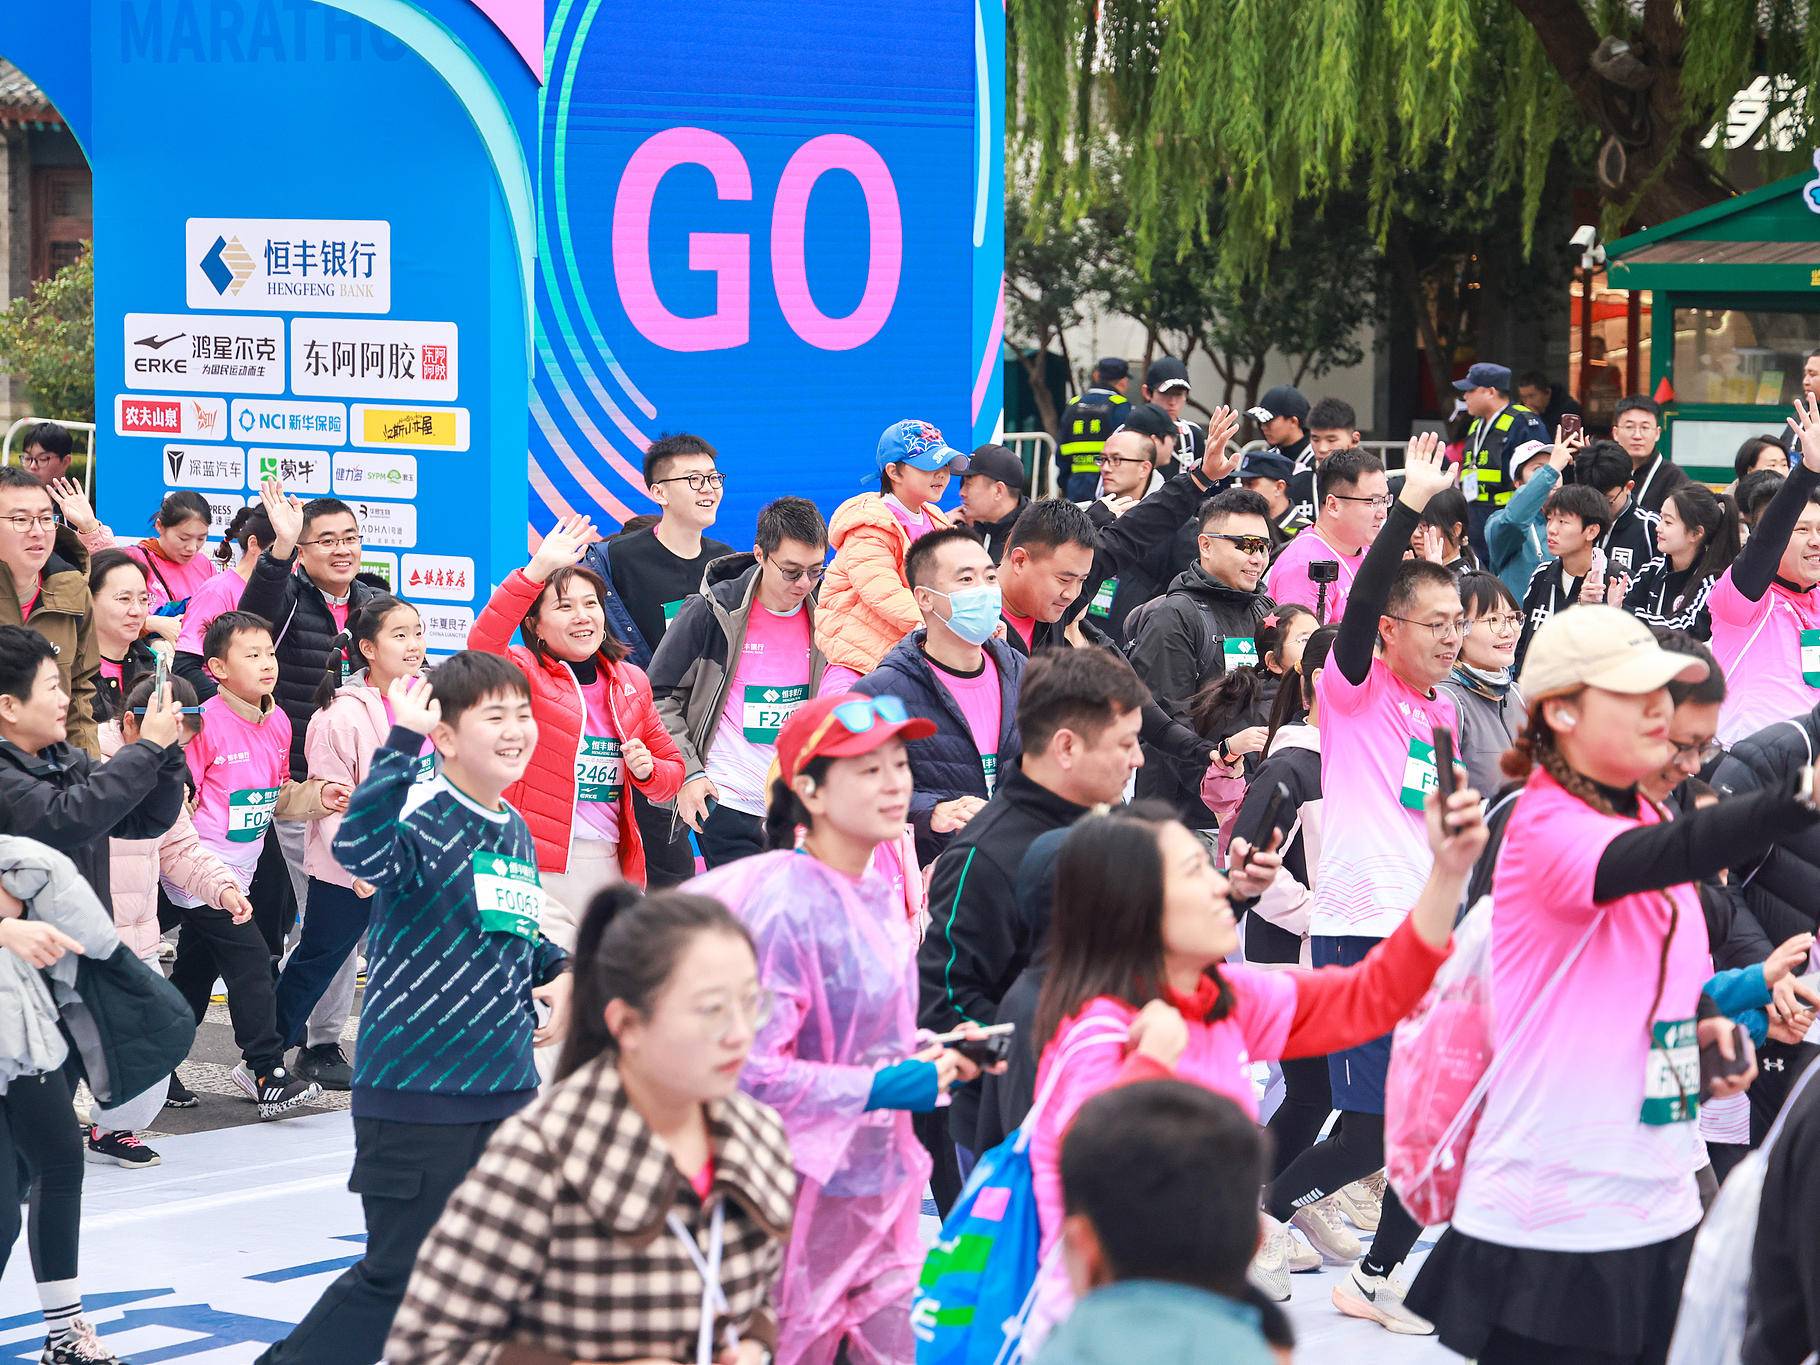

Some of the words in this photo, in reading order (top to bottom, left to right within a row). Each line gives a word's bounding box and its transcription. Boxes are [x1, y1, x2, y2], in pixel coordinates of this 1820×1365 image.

[612, 127, 902, 351] GO
[264, 239, 376, 278] 恒丰银行
[267, 282, 335, 297] HENGFENG
[340, 284, 375, 298] BANK
[192, 335, 275, 360] 鸿星尔克
[134, 358, 187, 373] ERKE
[304, 340, 415, 380] 东阿阿胶
[202, 364, 266, 377] 为国民运动而生
[126, 406, 177, 427] 农夫山泉
[259, 414, 286, 430] NCI
[289, 415, 341, 432] 新华保险
[189, 459, 241, 478] 深蓝汽车
[281, 459, 314, 483] 蒙牛
[336, 466, 363, 481] 健力多
[209, 505, 231, 514] PRESS
[424, 568, 465, 587] 银座家居
[430, 617, 466, 630] 华夏良子
[577, 764, 617, 783] 2464
[496, 887, 539, 918] F0063
